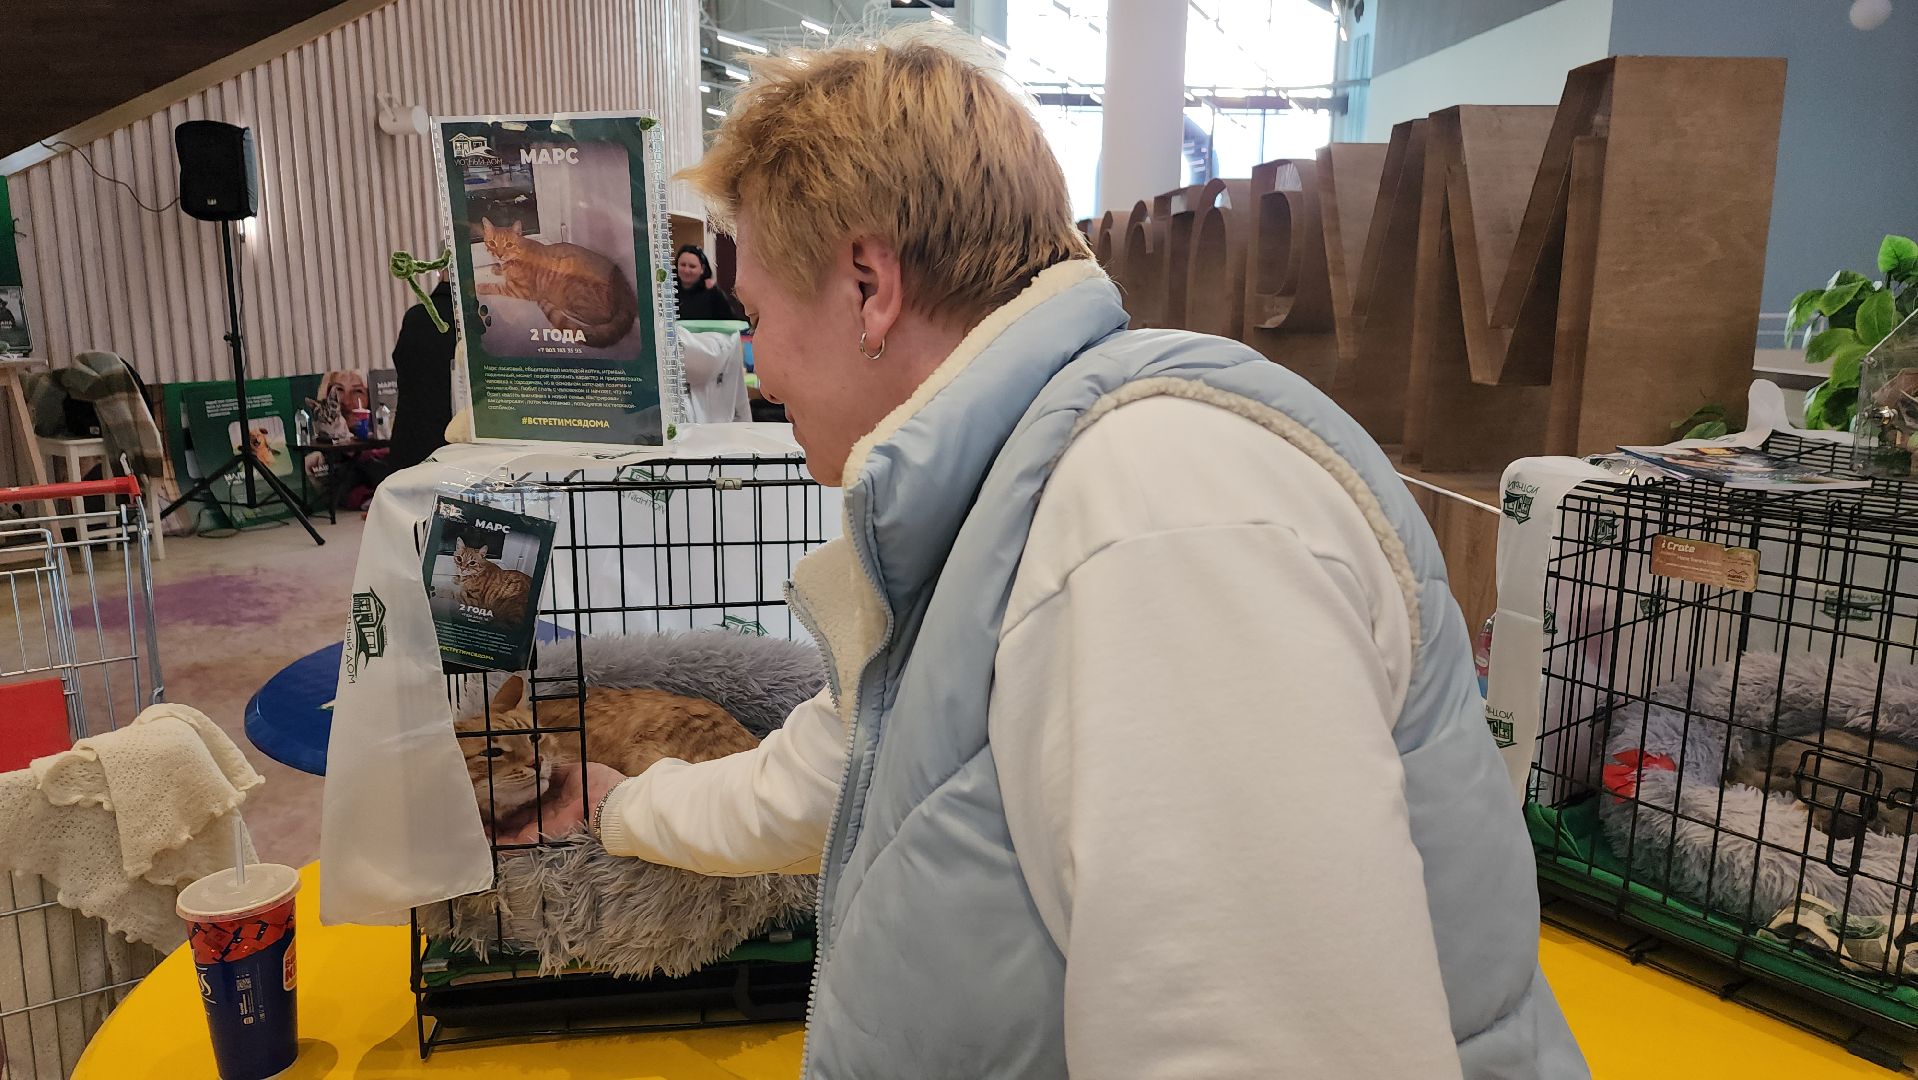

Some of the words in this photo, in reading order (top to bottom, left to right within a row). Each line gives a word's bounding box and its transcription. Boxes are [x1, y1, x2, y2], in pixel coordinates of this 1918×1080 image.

[520, 148, 579, 164] МАРС
[529, 328, 539, 341] 2
[543, 328, 586, 343] ГОДА
[521, 416, 610, 428] #ВСТРЕТИМСЯДОМА
[475, 519, 511, 533] МАРС
[1667, 541, 1695, 553] Crate
[467, 605, 494, 618] ГОДА
[346, 654, 356, 684] ДОМ
